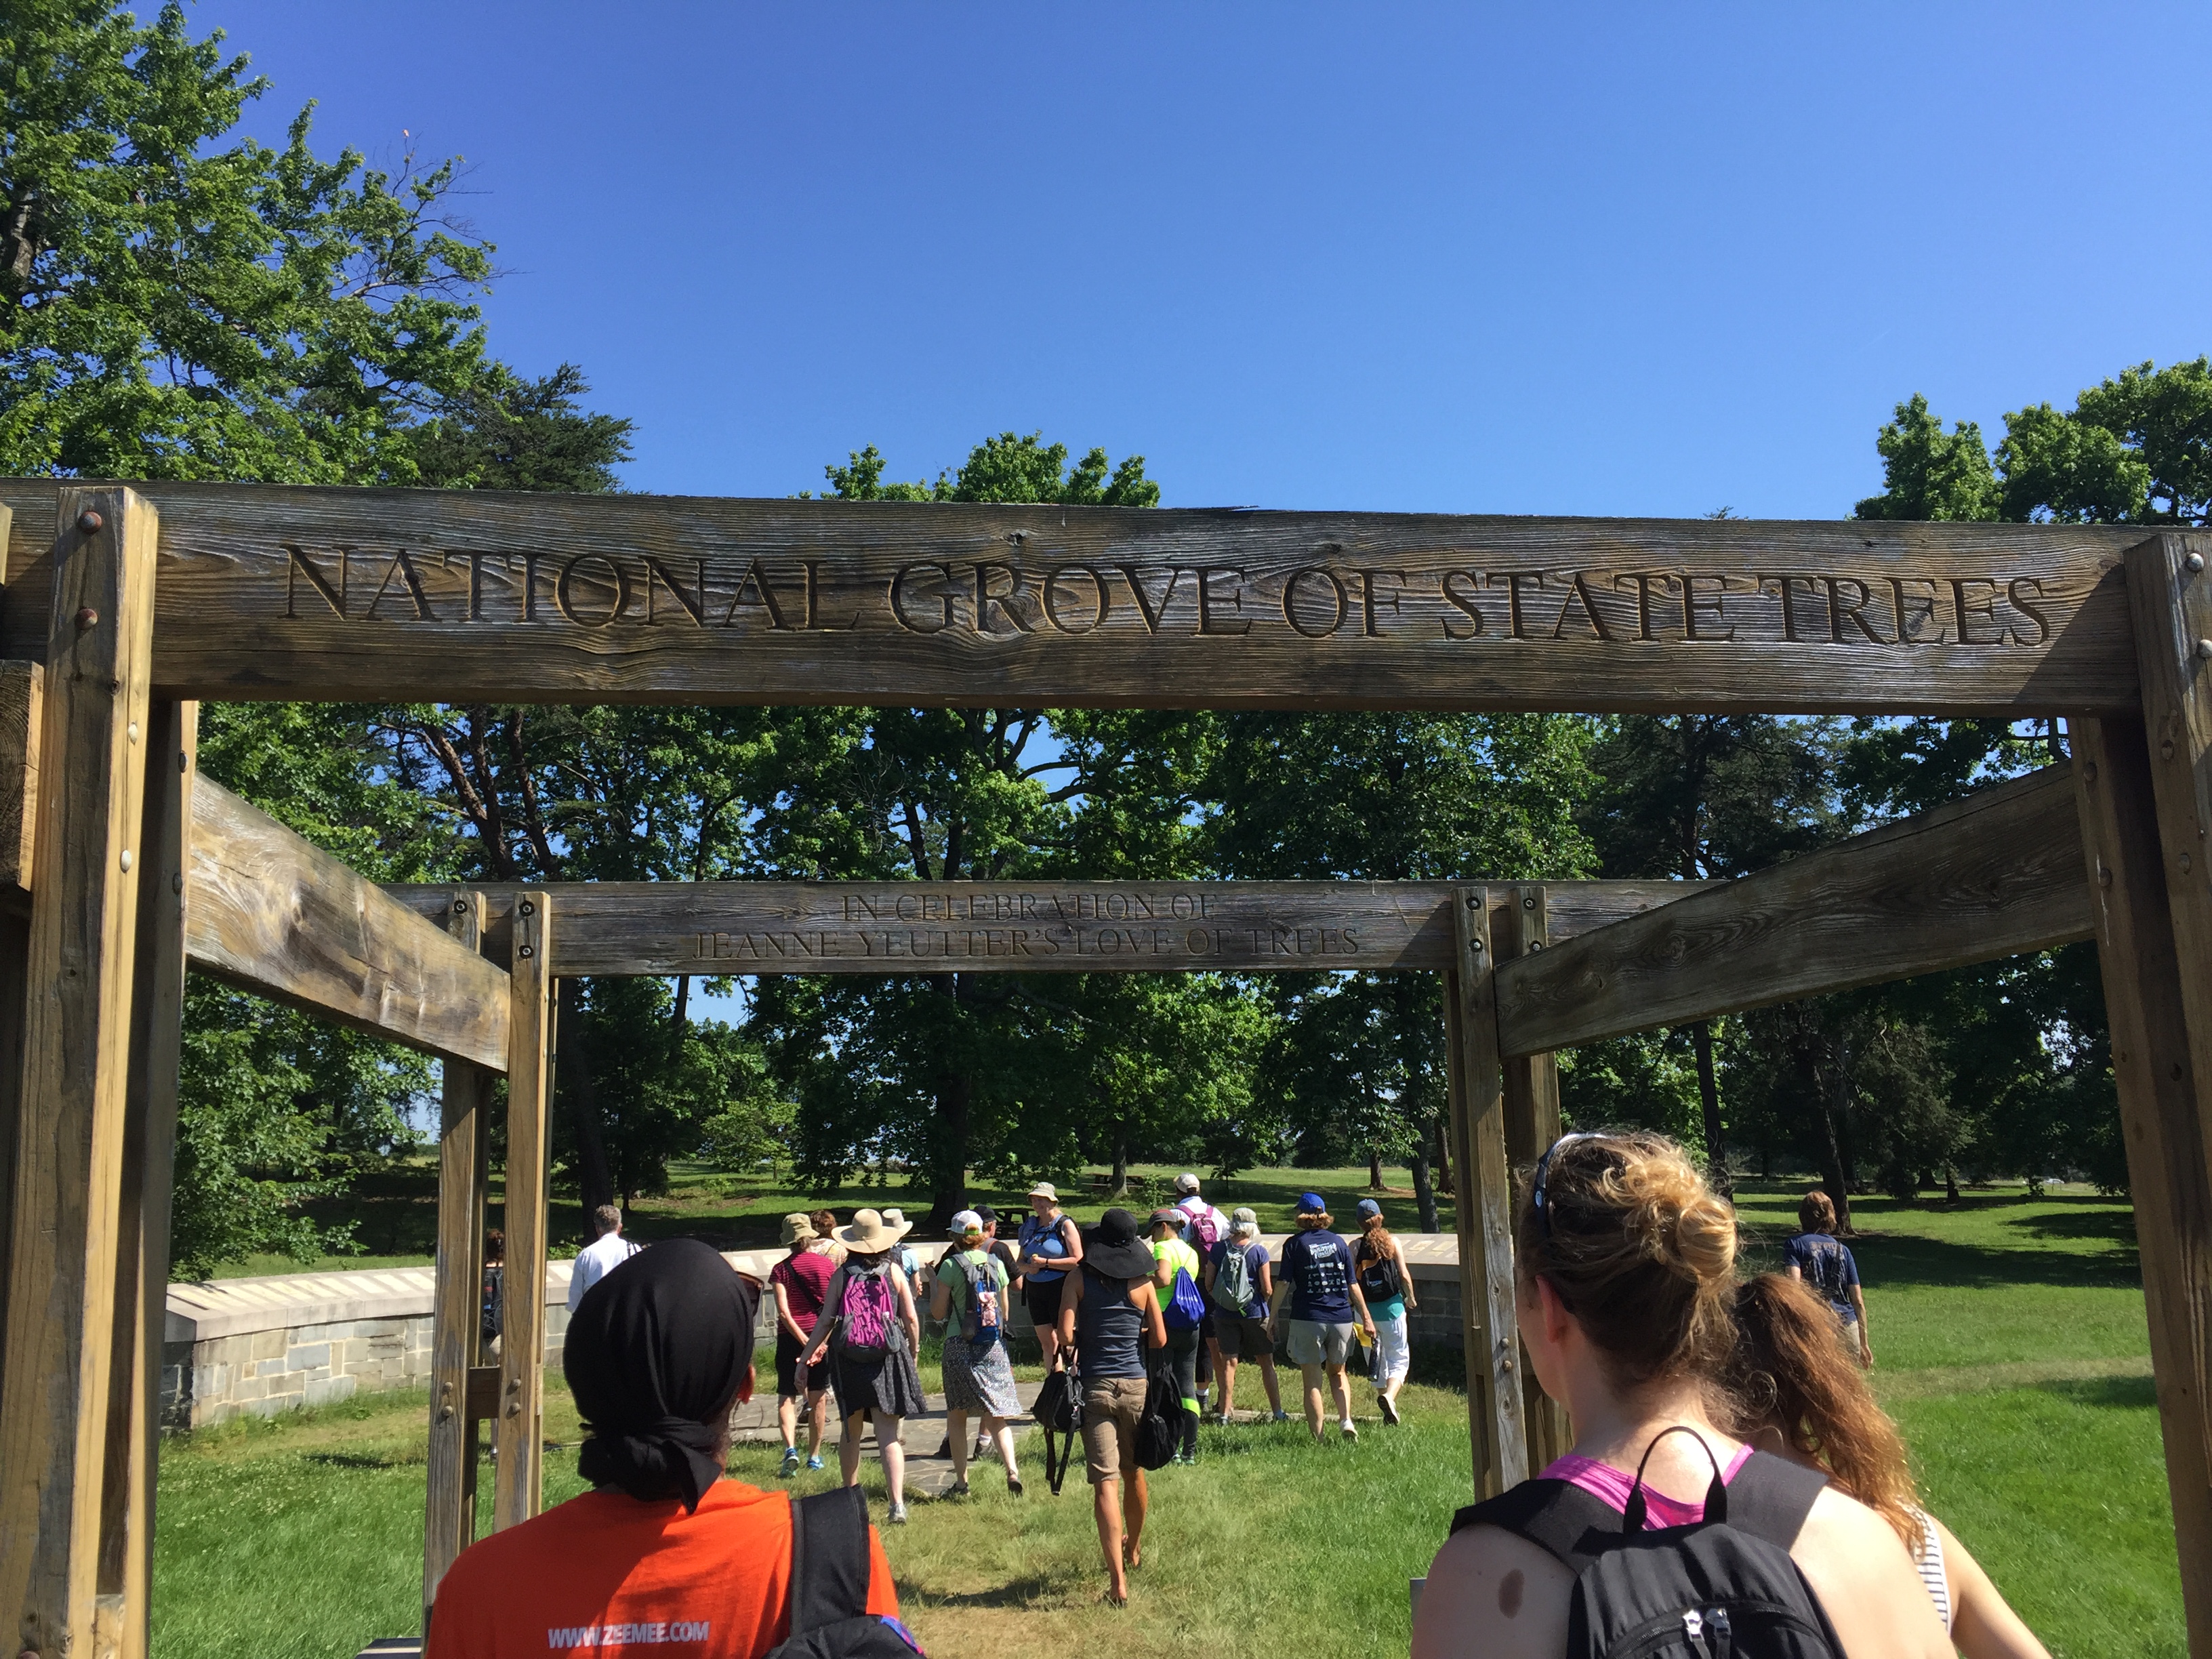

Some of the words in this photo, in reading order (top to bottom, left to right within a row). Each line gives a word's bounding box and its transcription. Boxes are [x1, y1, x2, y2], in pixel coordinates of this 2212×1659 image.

[277, 543, 860, 631] NATIONAL
[888, 560, 1252, 637] GROVE
[1282, 568, 1408, 638] OF
[1439, 570, 1736, 642] STATE
[1755, 575, 2051, 647] TREES
[842, 895, 878, 921] IN
[895, 893, 1155, 921] CELEBRATION
[1170, 893, 1218, 920] OF
[693, 932, 840, 960] JEANNE
[857, 928, 1060, 958] YEUTTER'S
[1073, 928, 1172, 956] LOVE
[1185, 928, 1232, 955] OF
[1245, 928, 1359, 955] TREES
[548, 1621, 710, 1649] WWW.ZEEMEE.COM
